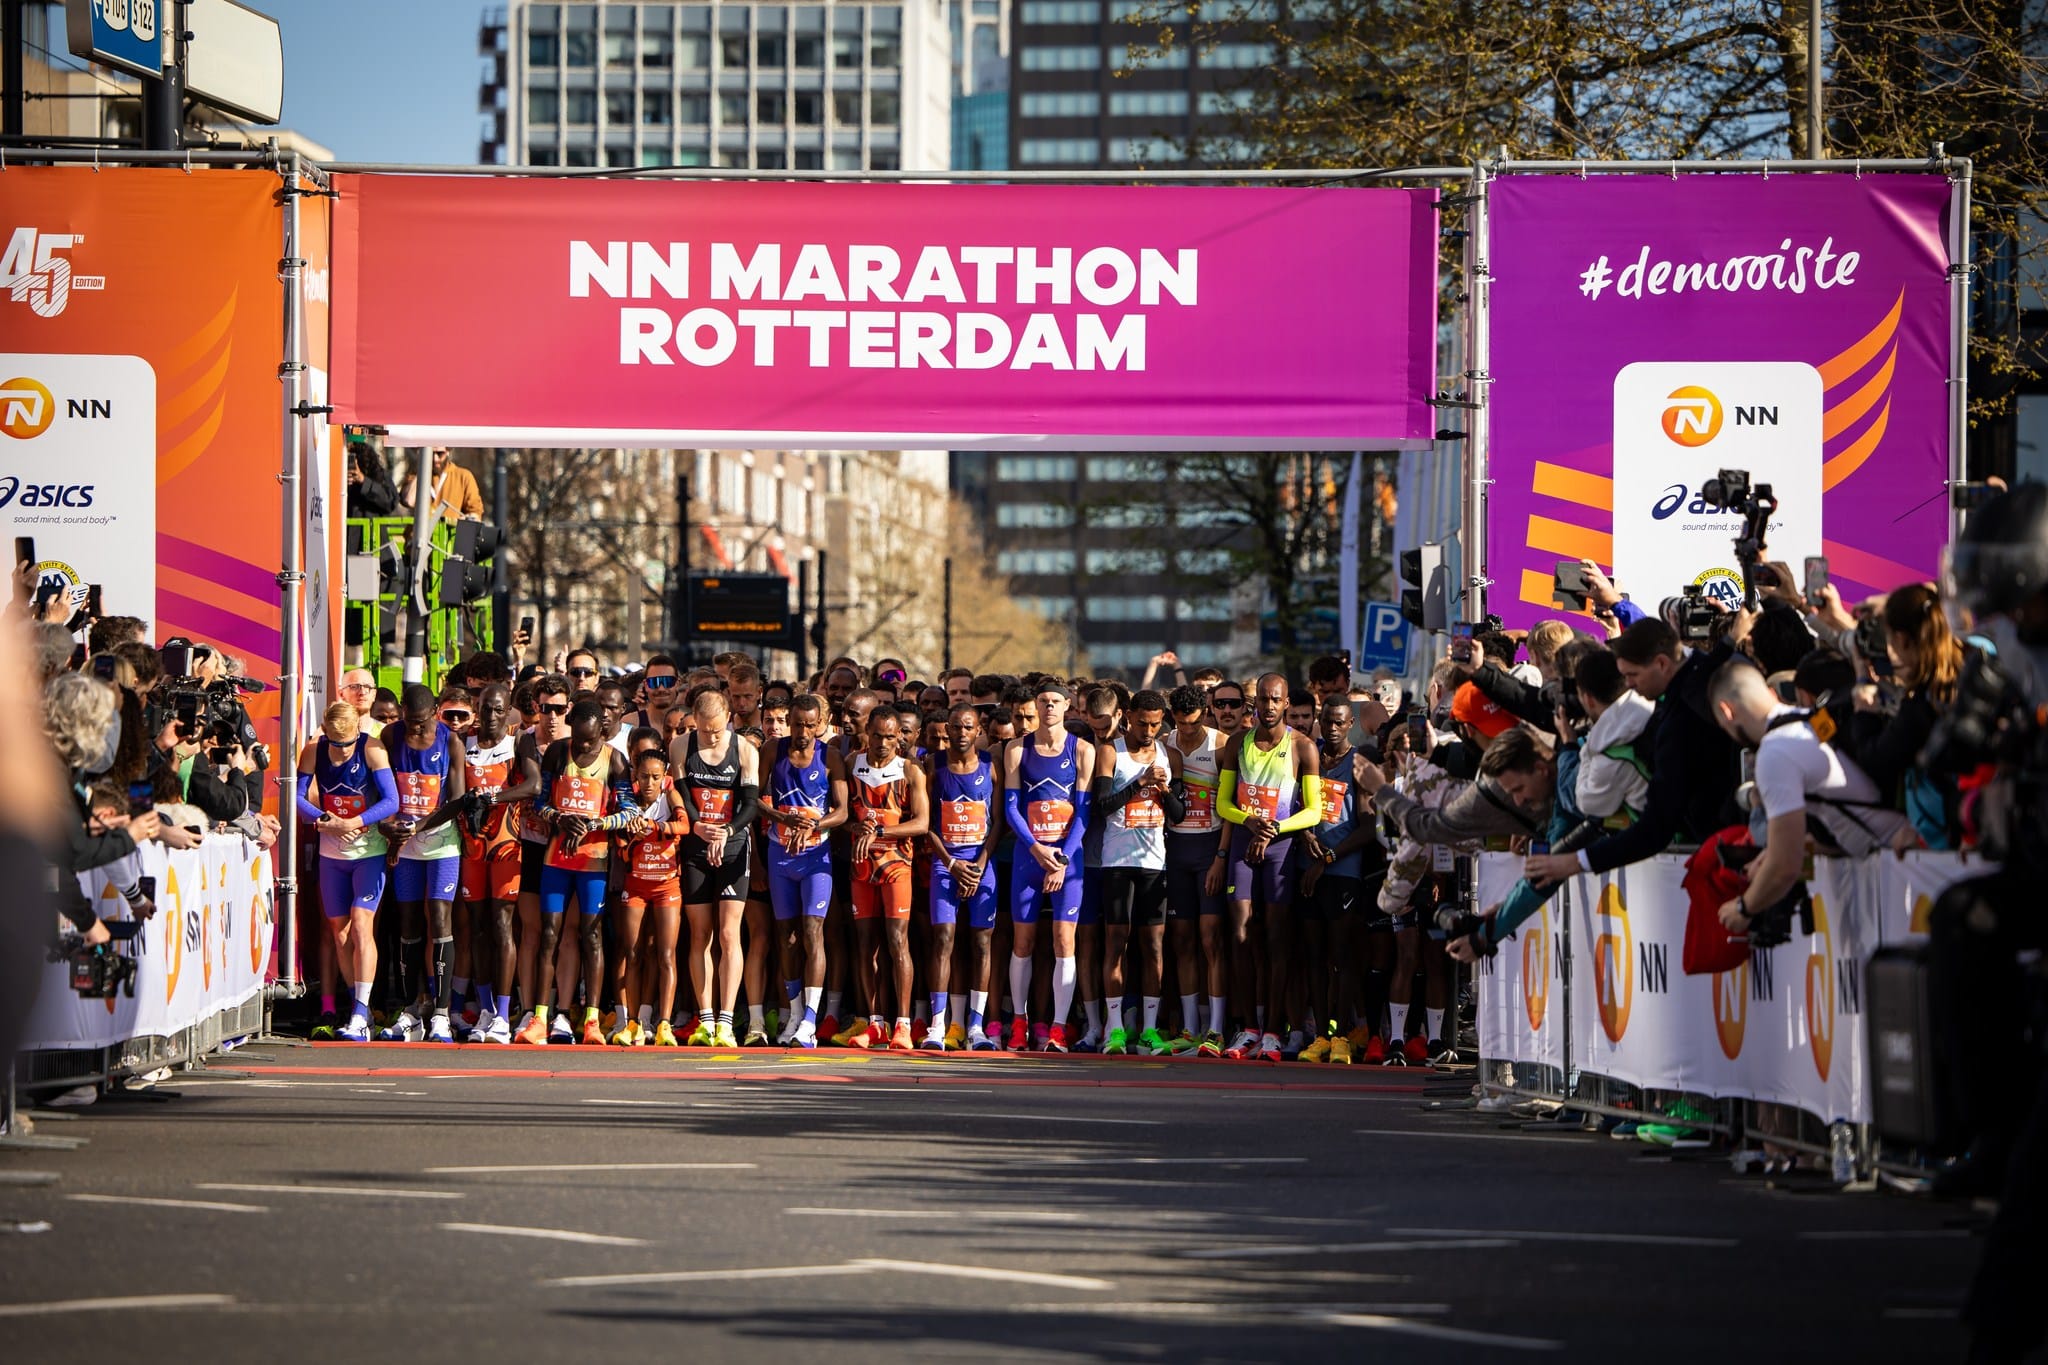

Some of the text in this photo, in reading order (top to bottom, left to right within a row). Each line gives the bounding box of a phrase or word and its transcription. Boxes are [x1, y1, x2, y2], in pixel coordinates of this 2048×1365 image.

[570, 241, 1198, 306] NN MARATHON
[1579, 236, 1861, 301] #demooiste
[74, 278, 103, 288] EDITION
[620, 307, 1147, 371] ROTTERDAM
[67, 399, 110, 418] NN
[1735, 406, 1778, 425] NN
[20, 485, 94, 507] asics
[13, 514, 39, 523] sound
[40, 514, 60, 524] mind,
[63, 516, 88, 524] sound
[1682, 523, 1706, 531] sound
[1707, 522, 1729, 532] mind,
[1374, 608, 1402, 643] P
[403, 794, 431, 806] BOIT
[562, 797, 595, 811] PACE
[1250, 798, 1260, 806] 70
[1241, 804, 1271, 819] PACE
[947, 823, 980, 832] TESFU
[1640, 941, 1667, 994] NN
[1838, 958, 1858, 1015] NN
